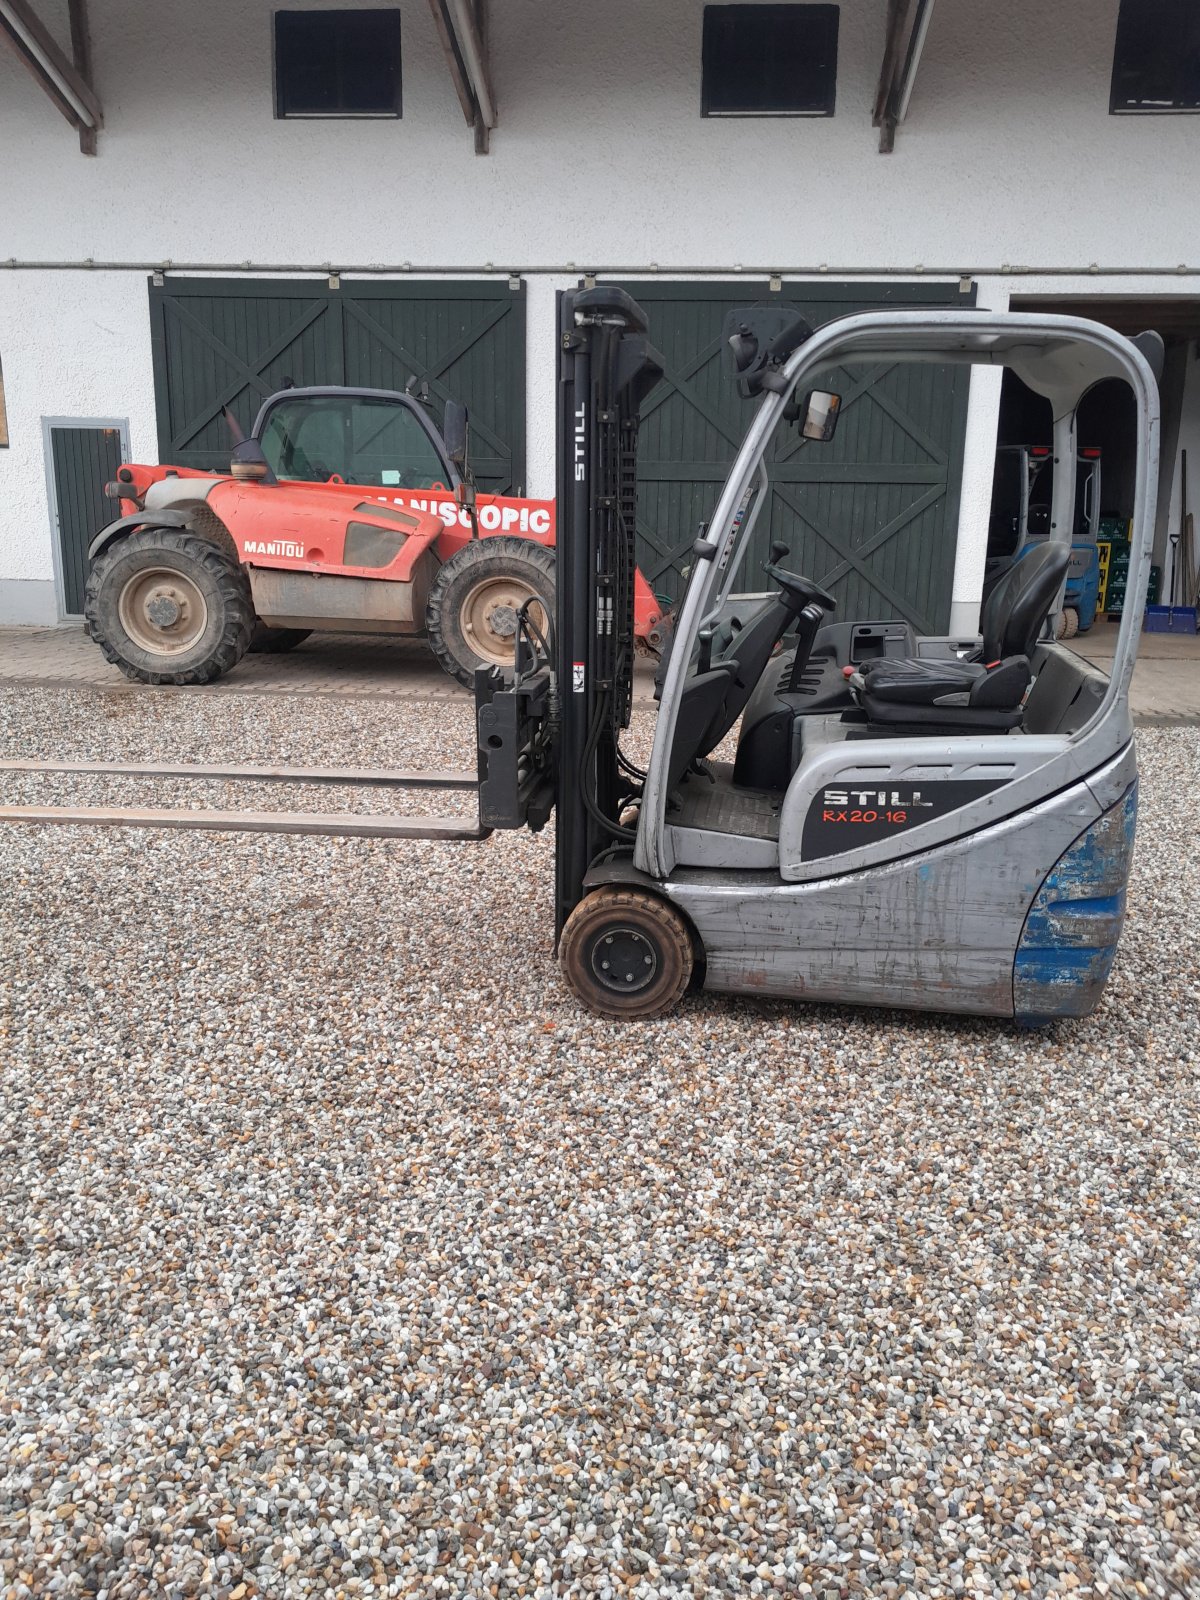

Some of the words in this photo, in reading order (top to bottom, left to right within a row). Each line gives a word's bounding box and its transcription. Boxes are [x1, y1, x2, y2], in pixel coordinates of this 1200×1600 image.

[574, 402, 585, 481] STILL
[363, 495, 551, 533] ISCOPIC
[244, 539, 304, 558] MANITOU
[823, 790, 934, 807] STILL
[822, 809, 907, 823] RX20-16
